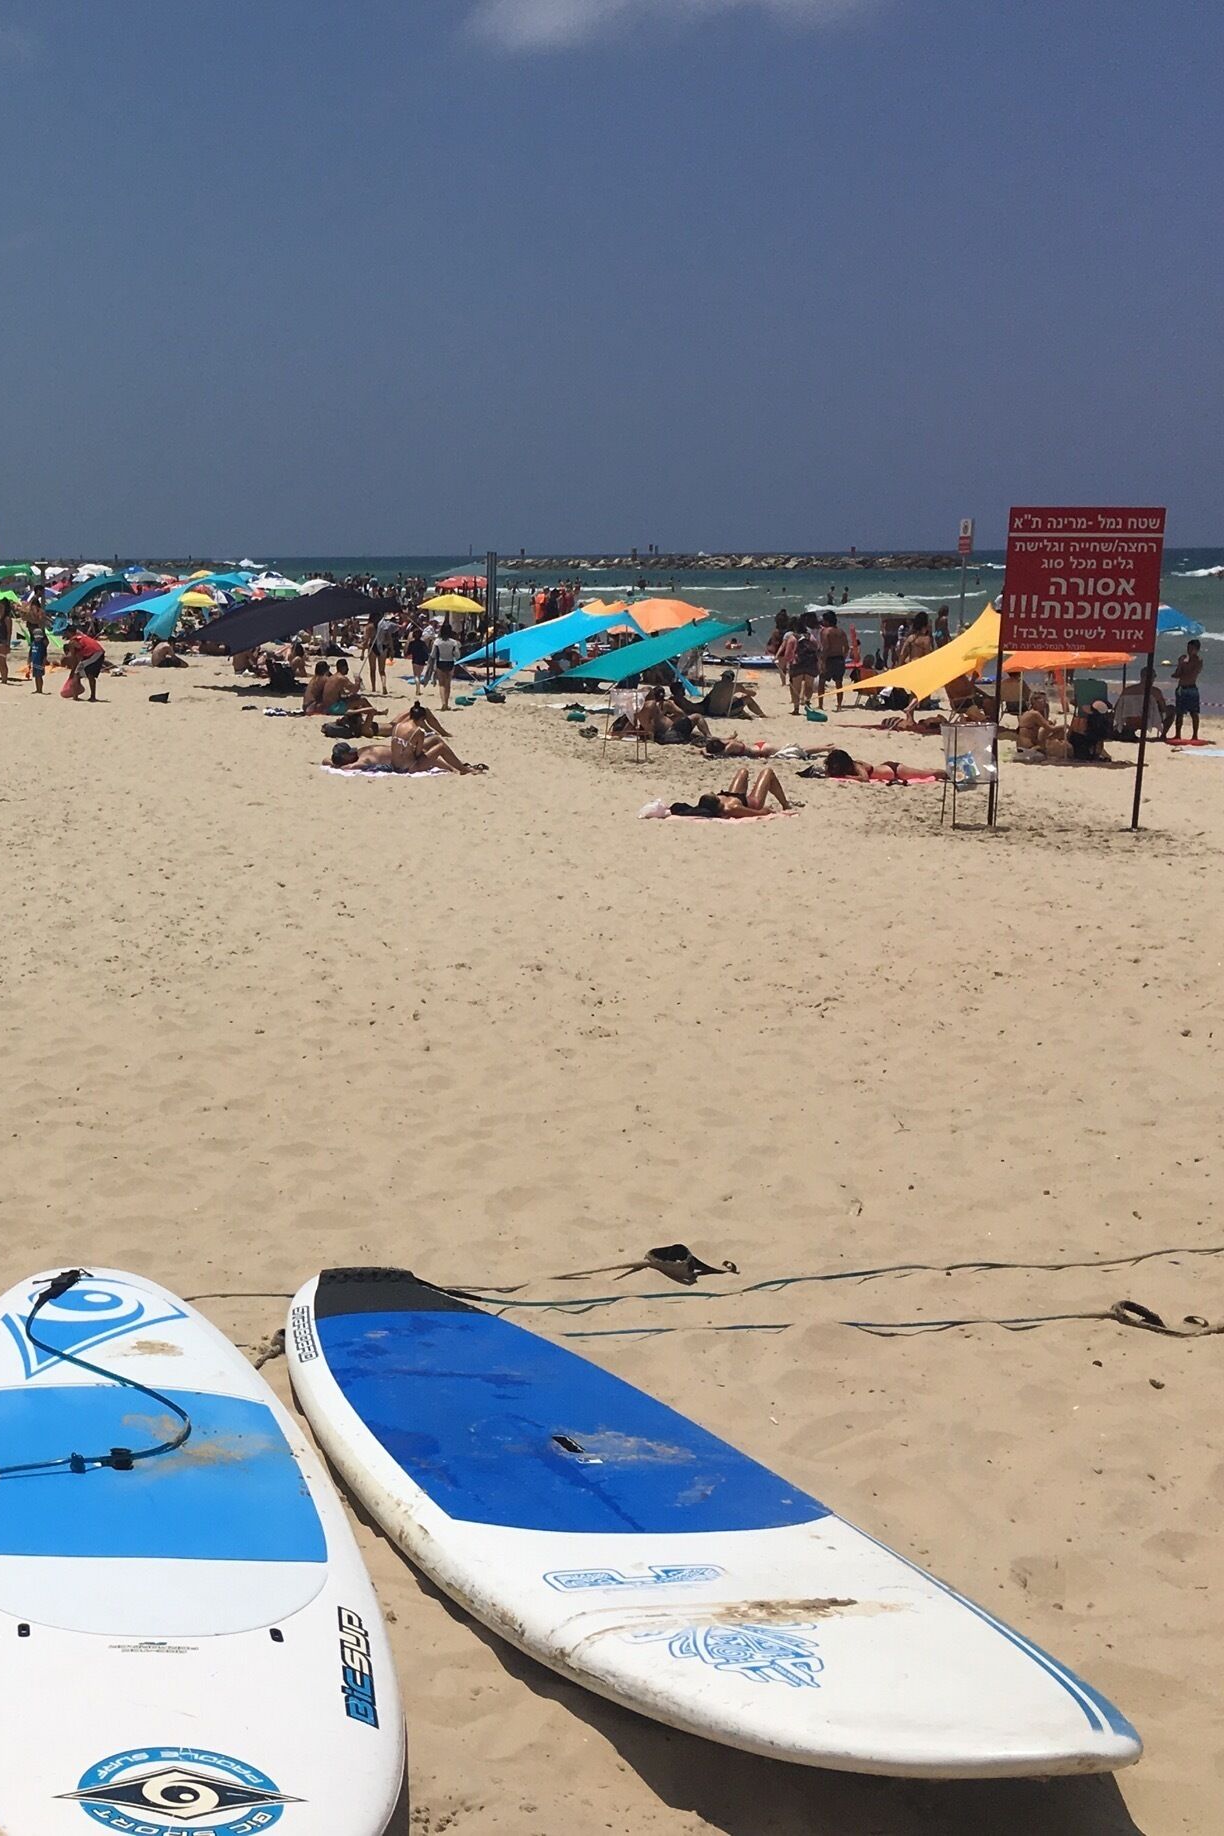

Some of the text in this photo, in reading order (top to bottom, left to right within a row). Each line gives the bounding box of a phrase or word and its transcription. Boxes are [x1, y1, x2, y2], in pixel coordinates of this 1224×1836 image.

[1013, 515, 1042, 529] ת"א
[1097, 514, 1123, 529] נמל
[1127, 517, 1160, 529] שטח
[1014, 539, 1157, 553] רחצה/שחייה וגלישת
[1040, 556, 1134, 569] גלים מכל סוג
[1049, 576, 1136, 596] אסורה
[1008, 595, 1152, 620] ומסוכנת!!!
[1012, 625, 1144, 640] אזור לשייט בלבד!
[97, 1750, 264, 1785] PADDLE SURF
